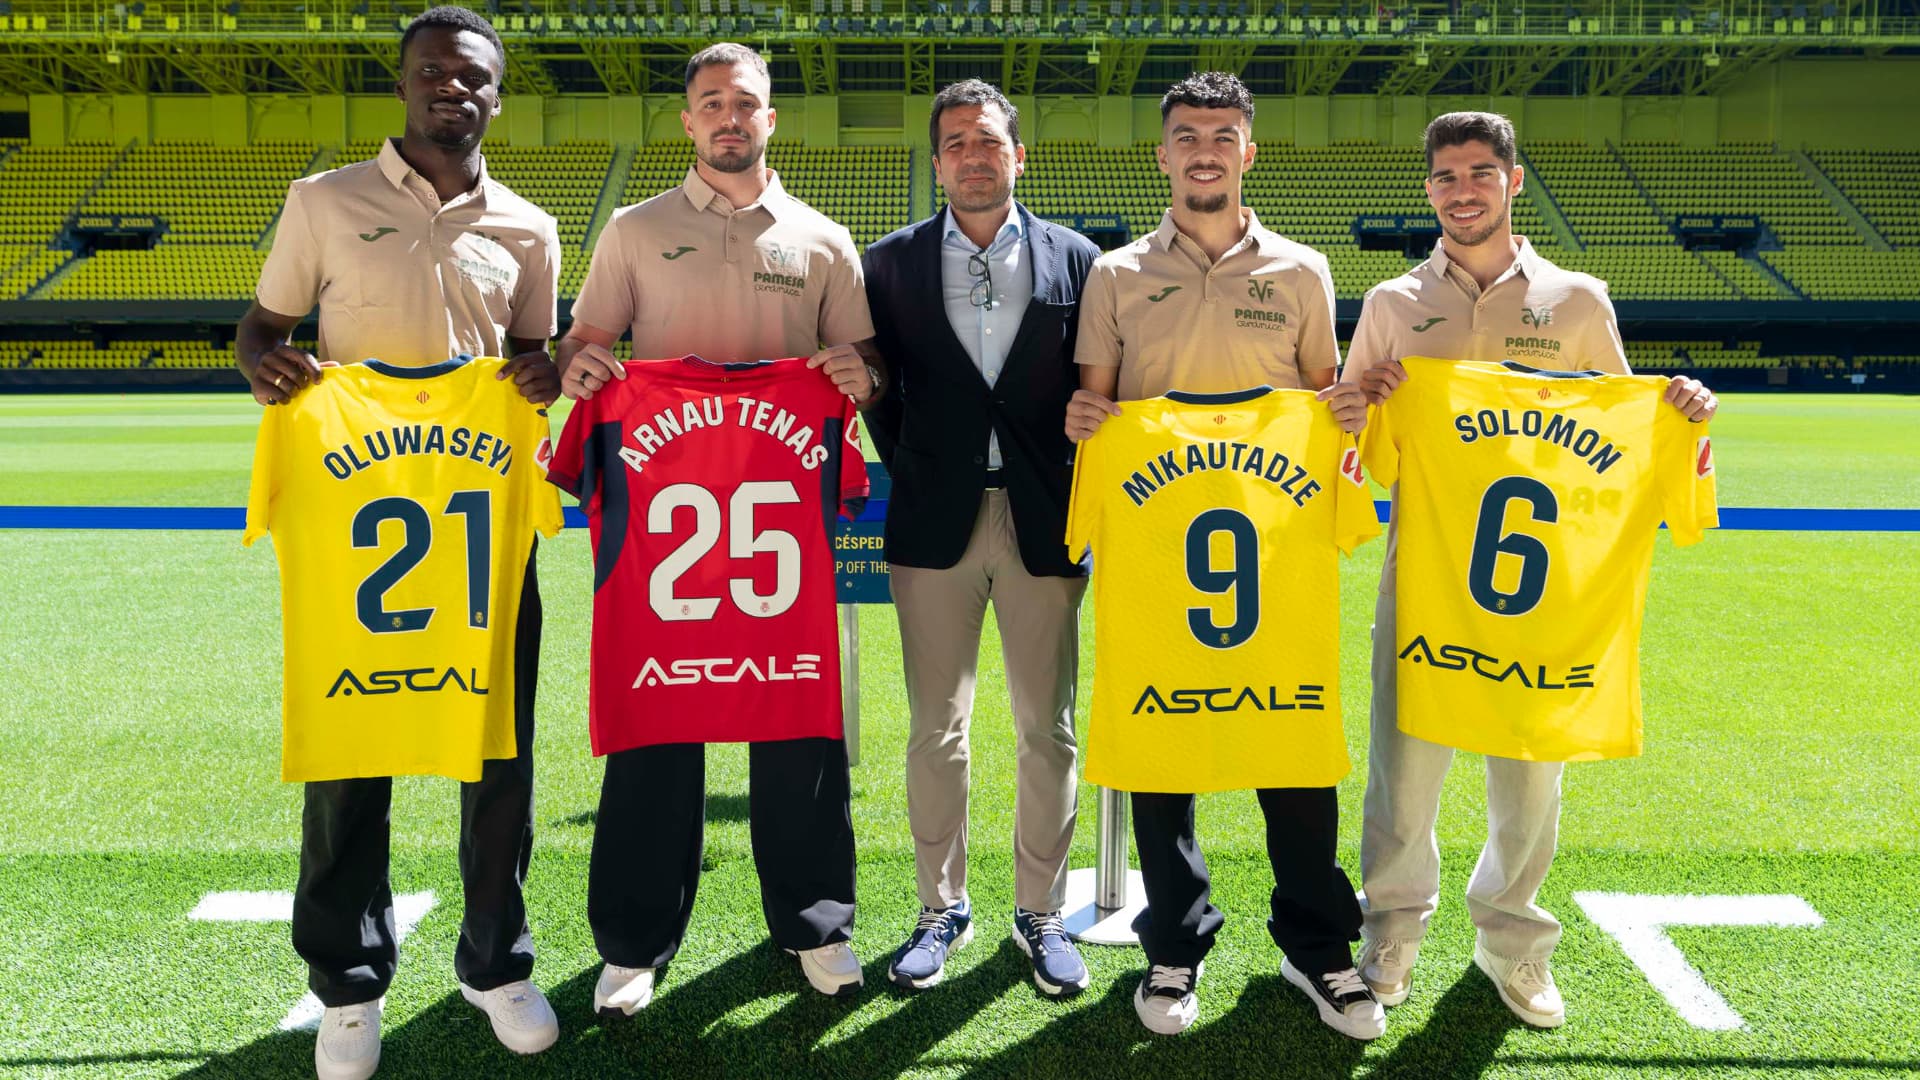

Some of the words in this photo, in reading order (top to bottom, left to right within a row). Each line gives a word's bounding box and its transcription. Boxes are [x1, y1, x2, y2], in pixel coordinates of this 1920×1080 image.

[753, 271, 806, 289] PAMESA
[1234, 308, 1287, 325] PAMESA
[1505, 336, 1561, 352] PAMESA
[618, 396, 725, 473] ARNAU
[736, 396, 829, 472] TENAS
[1454, 408, 1623, 475] SOLOMON
[1121, 441, 1323, 508] MIKAUTADZE
[350, 488, 491, 635] 21
[646, 480, 801, 622] 25
[835, 534, 884, 550] CÉSPED
[846, 561, 867, 574] OFF
[1468, 475, 1559, 616] 6
[1184, 506, 1261, 650] 9
[632, 653, 821, 690] ASCALE
[1398, 634, 1595, 690] ASCALE
[1131, 684, 1325, 716] ASCALE
